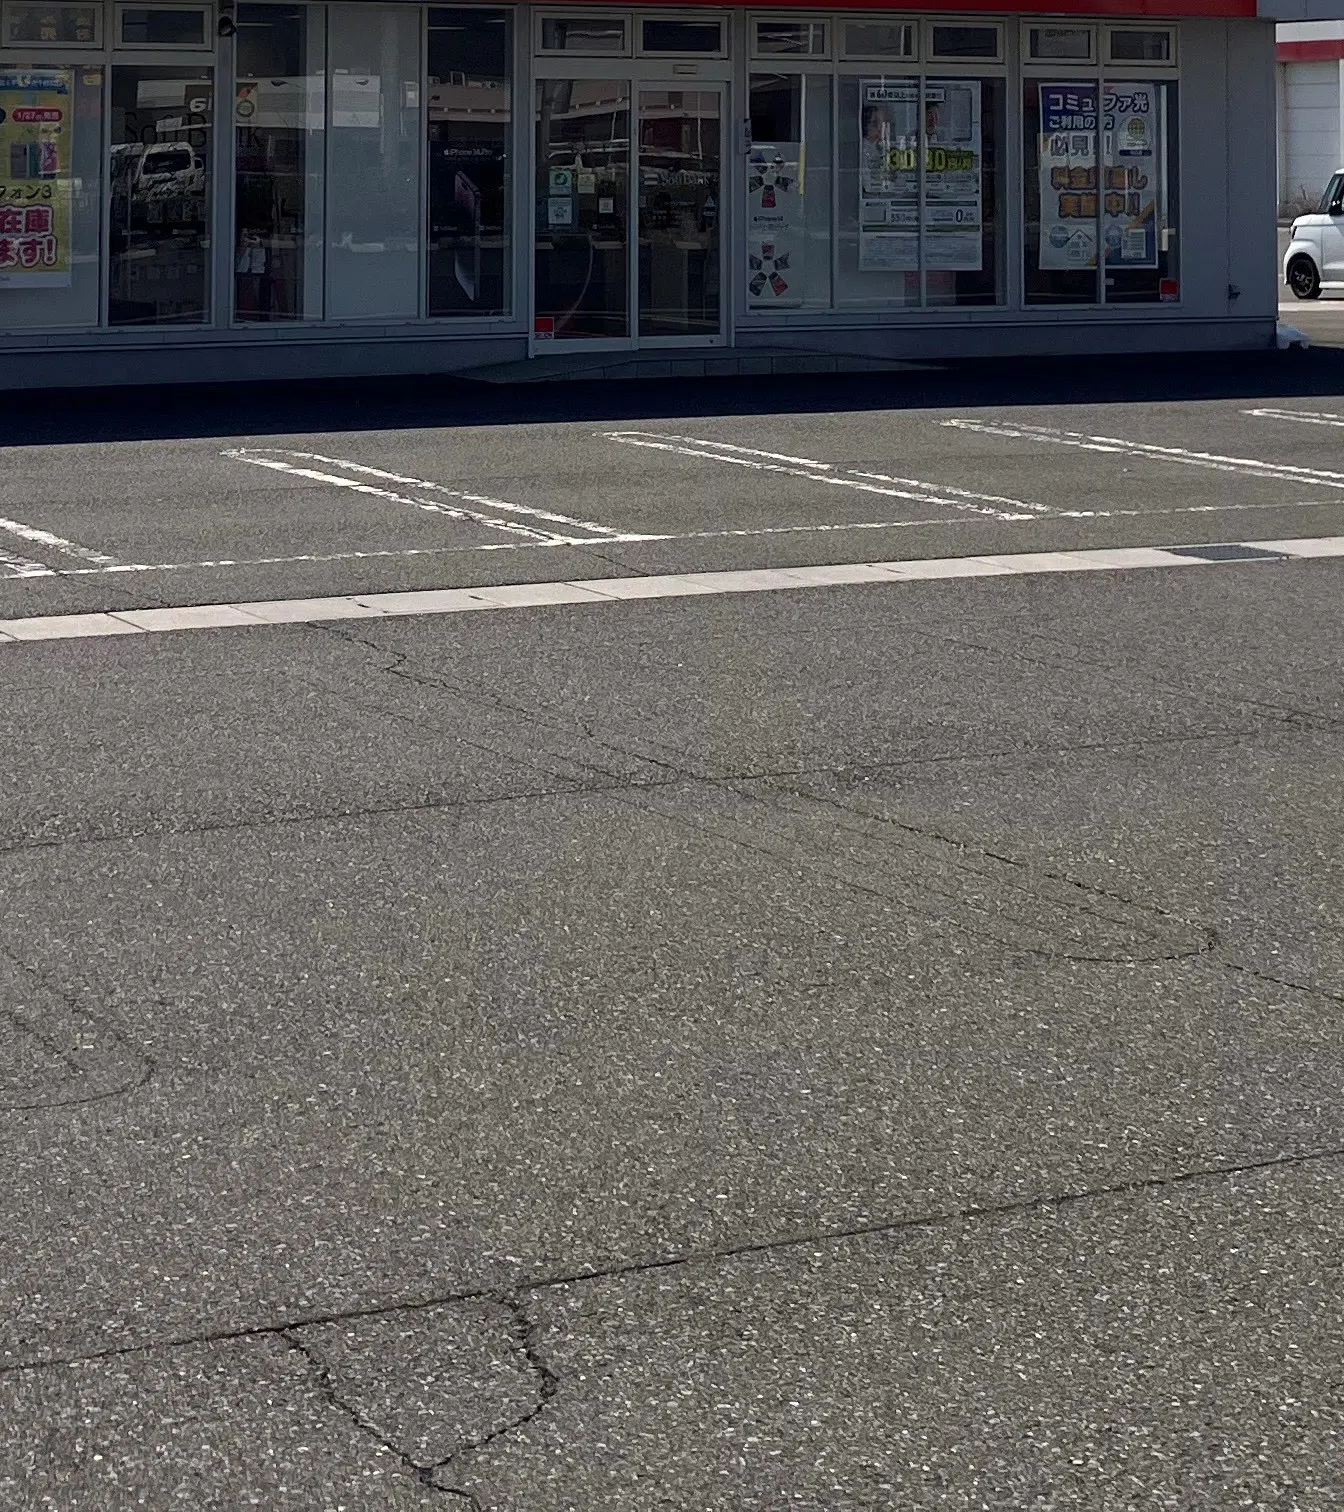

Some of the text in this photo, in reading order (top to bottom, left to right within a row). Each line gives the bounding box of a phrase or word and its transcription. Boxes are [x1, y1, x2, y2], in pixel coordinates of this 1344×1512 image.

[1048, 92, 1148, 113] コミュファ光
